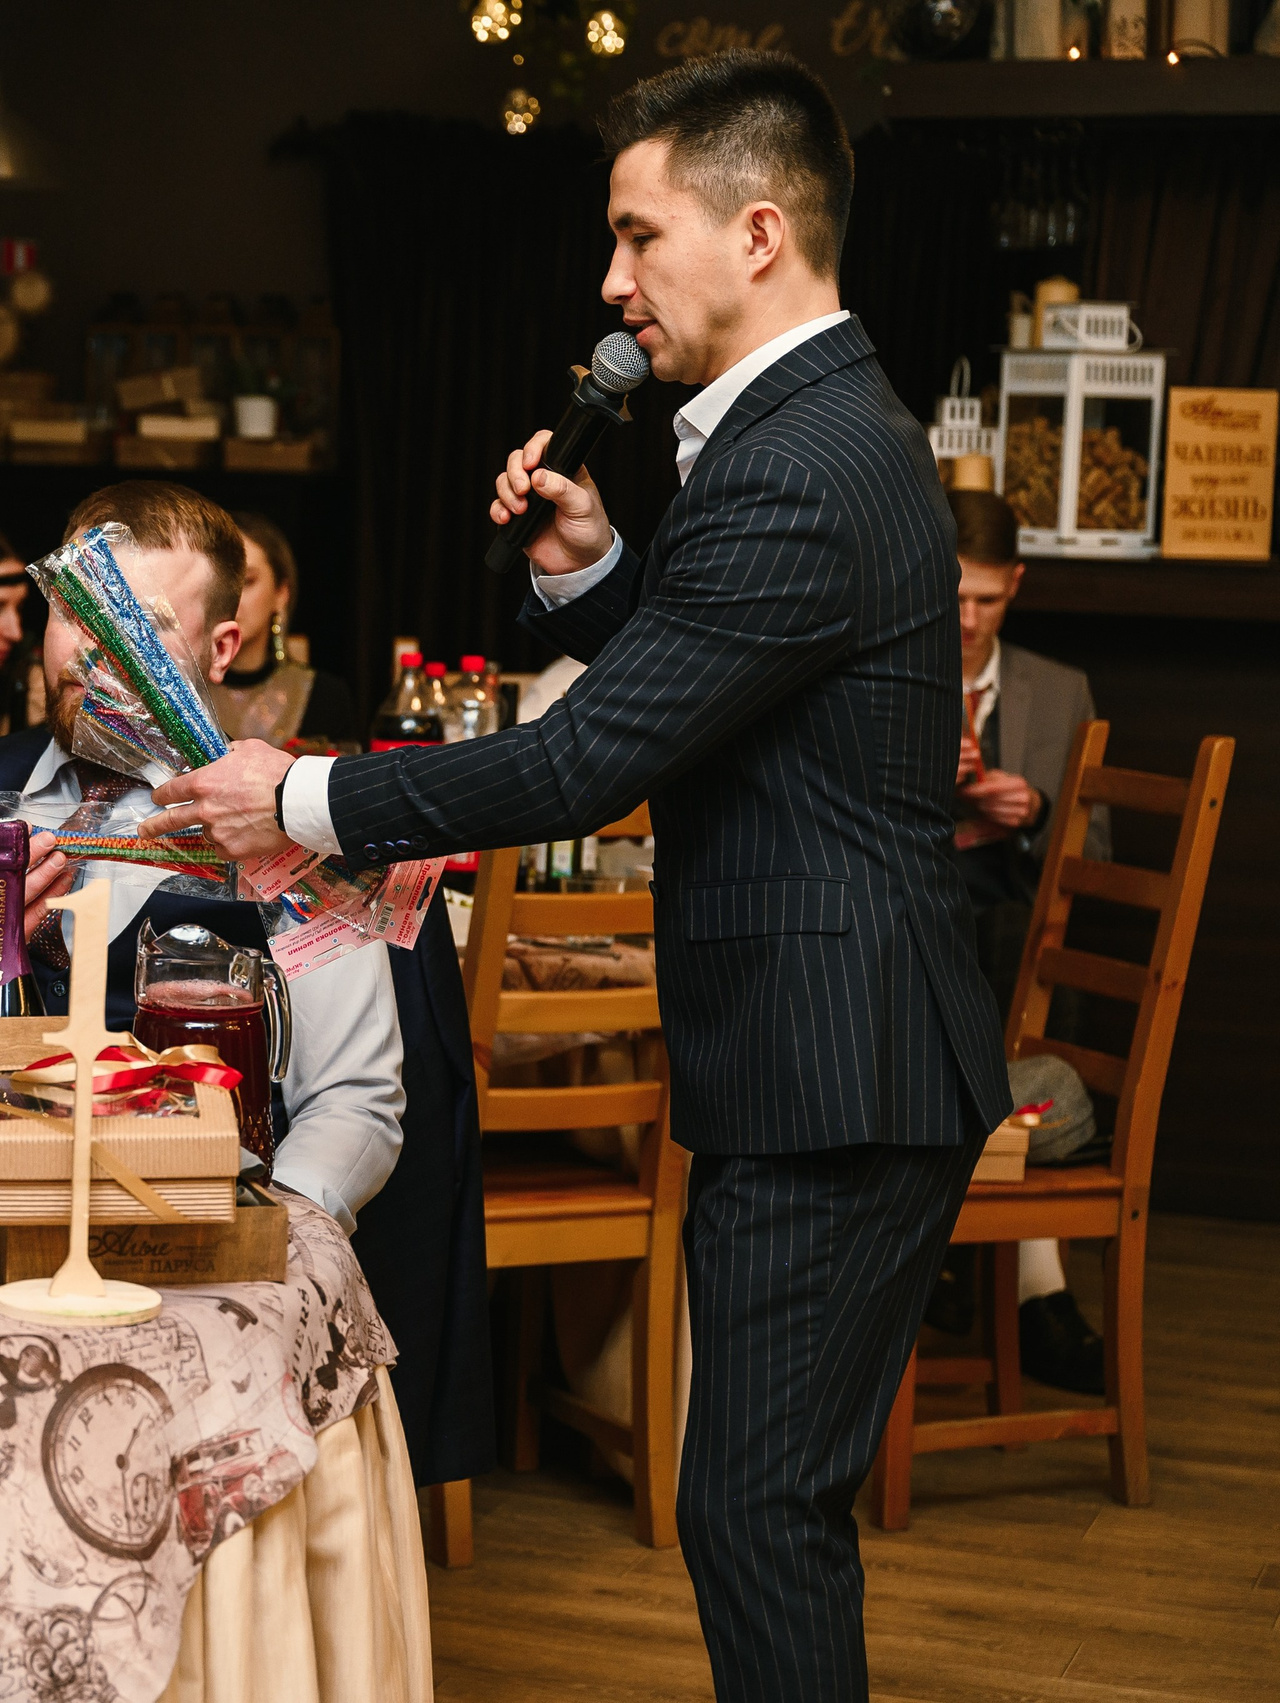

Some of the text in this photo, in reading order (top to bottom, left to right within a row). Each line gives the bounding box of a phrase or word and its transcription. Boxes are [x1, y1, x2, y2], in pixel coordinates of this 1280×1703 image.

[1171, 494, 1267, 521] ЖИЗНЬ
[396, 864, 431, 943] Проволока шенил
[287, 940, 314, 957] шенил
[149, 1259, 216, 1273] ПАРУСА
